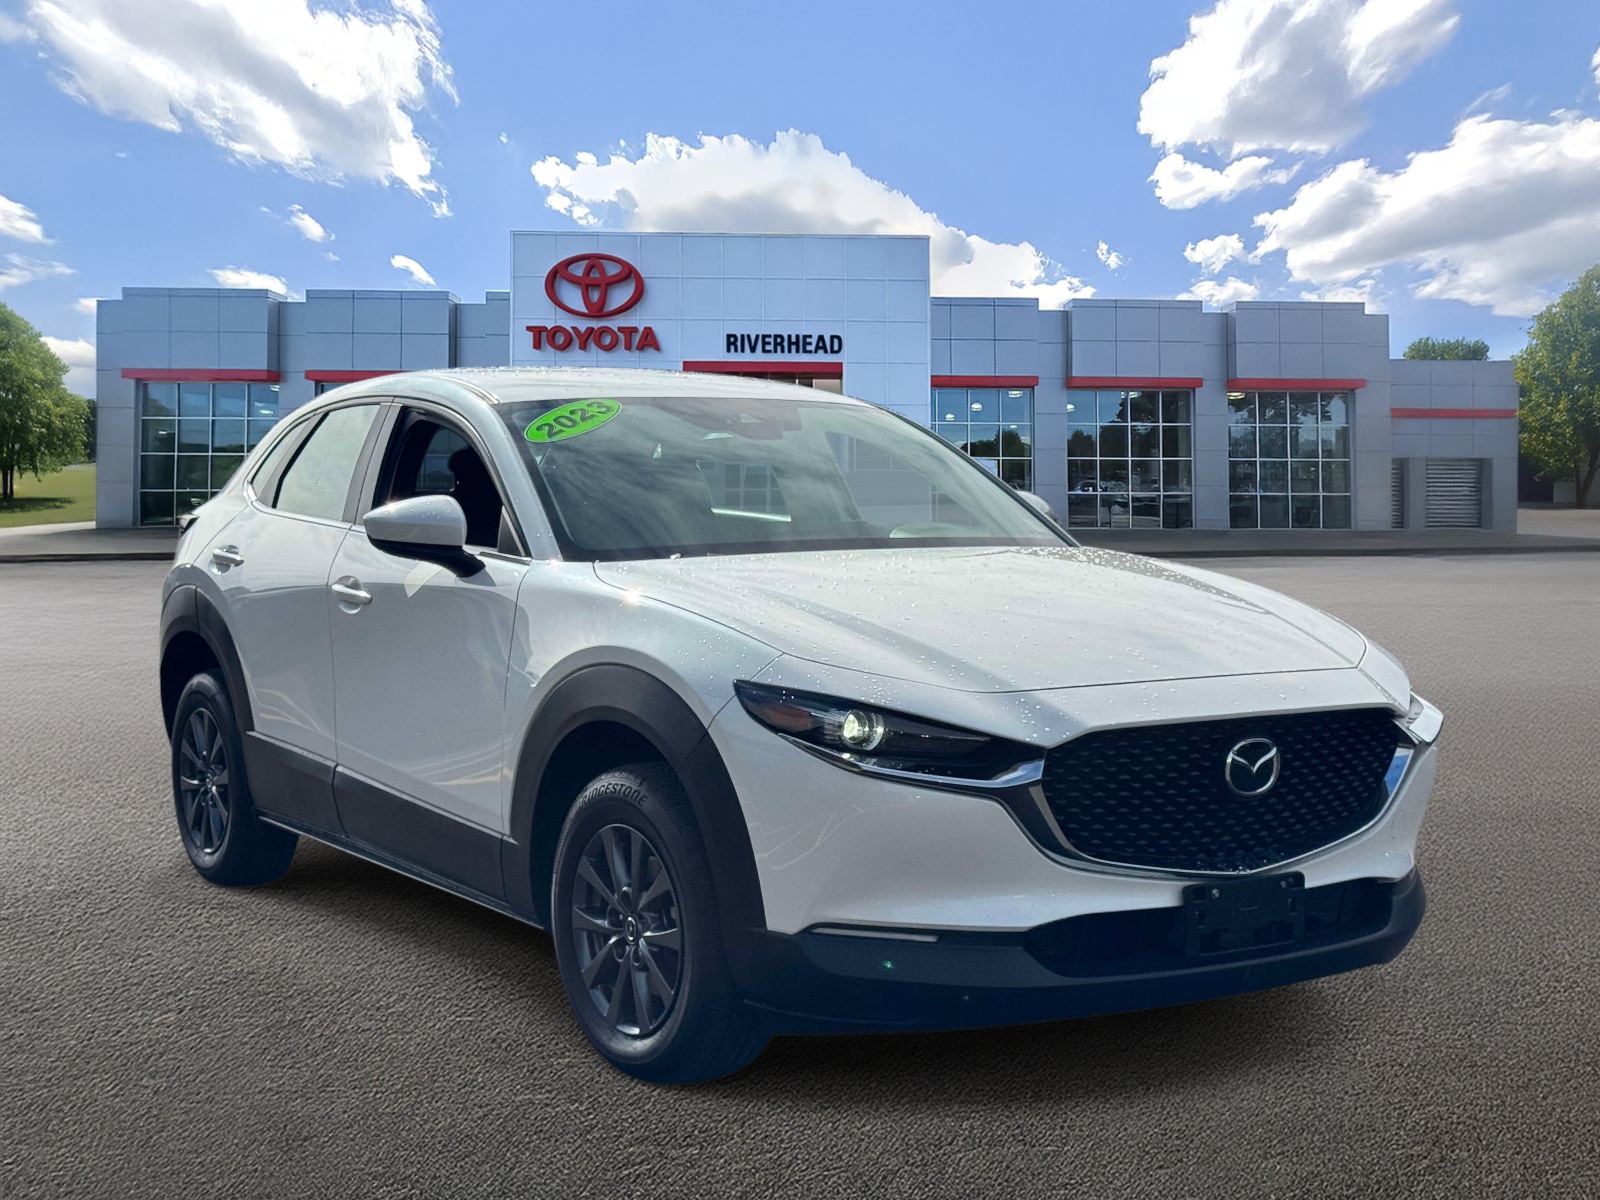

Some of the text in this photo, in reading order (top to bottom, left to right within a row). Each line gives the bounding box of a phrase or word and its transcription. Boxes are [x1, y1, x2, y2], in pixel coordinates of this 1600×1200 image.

[526, 325, 661, 351] TOYOTA
[726, 334, 843, 354] RIVERHEAD
[535, 401, 614, 439] 2023
